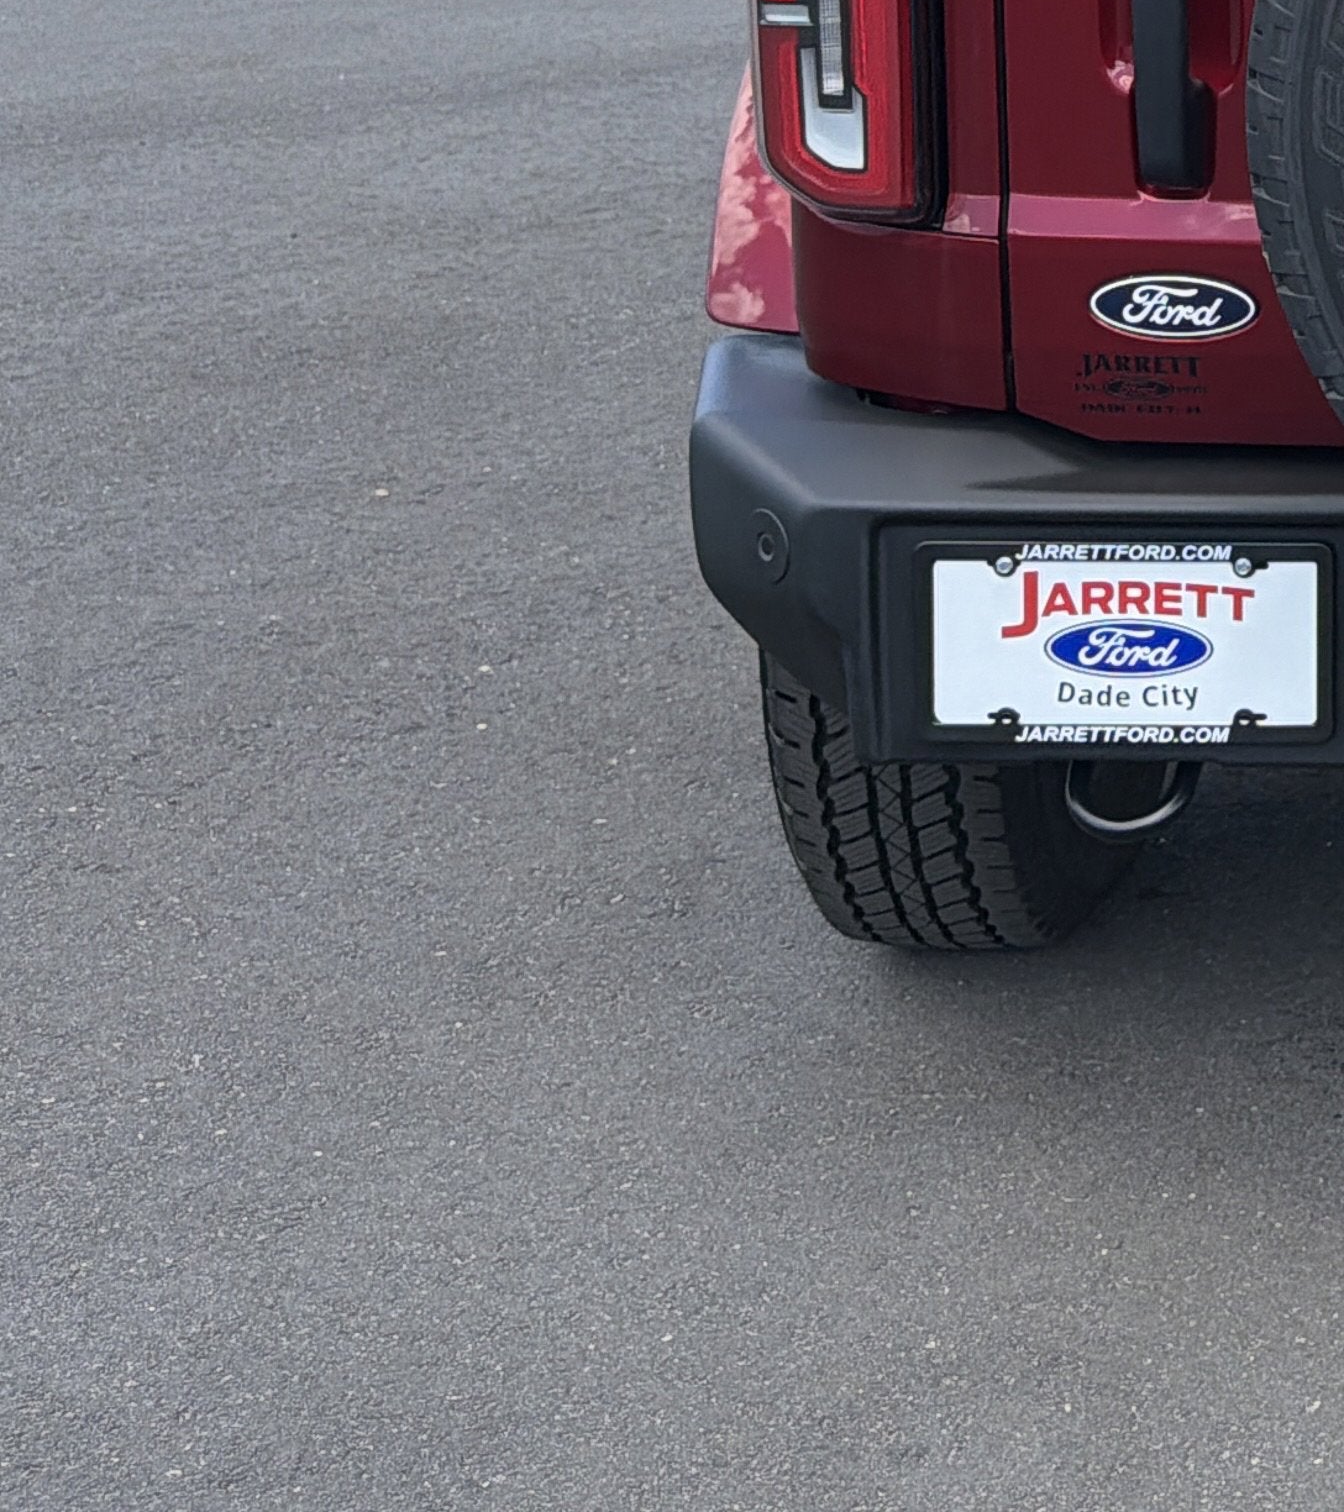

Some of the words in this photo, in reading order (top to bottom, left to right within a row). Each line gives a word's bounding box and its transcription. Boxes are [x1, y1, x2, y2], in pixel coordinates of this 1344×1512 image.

[1122, 284, 1222, 327] Ford
[1076, 353, 1201, 378] JARRETT
[1015, 544, 1233, 562] JARRETTFORD.COM
[1001, 571, 1256, 639] JARRETT
[1078, 628, 1180, 667] Ford
[1057, 681, 1131, 708] Dade
[1142, 684, 1200, 711] City
[1015, 725, 1230, 744] JARRETTFORD.COM
